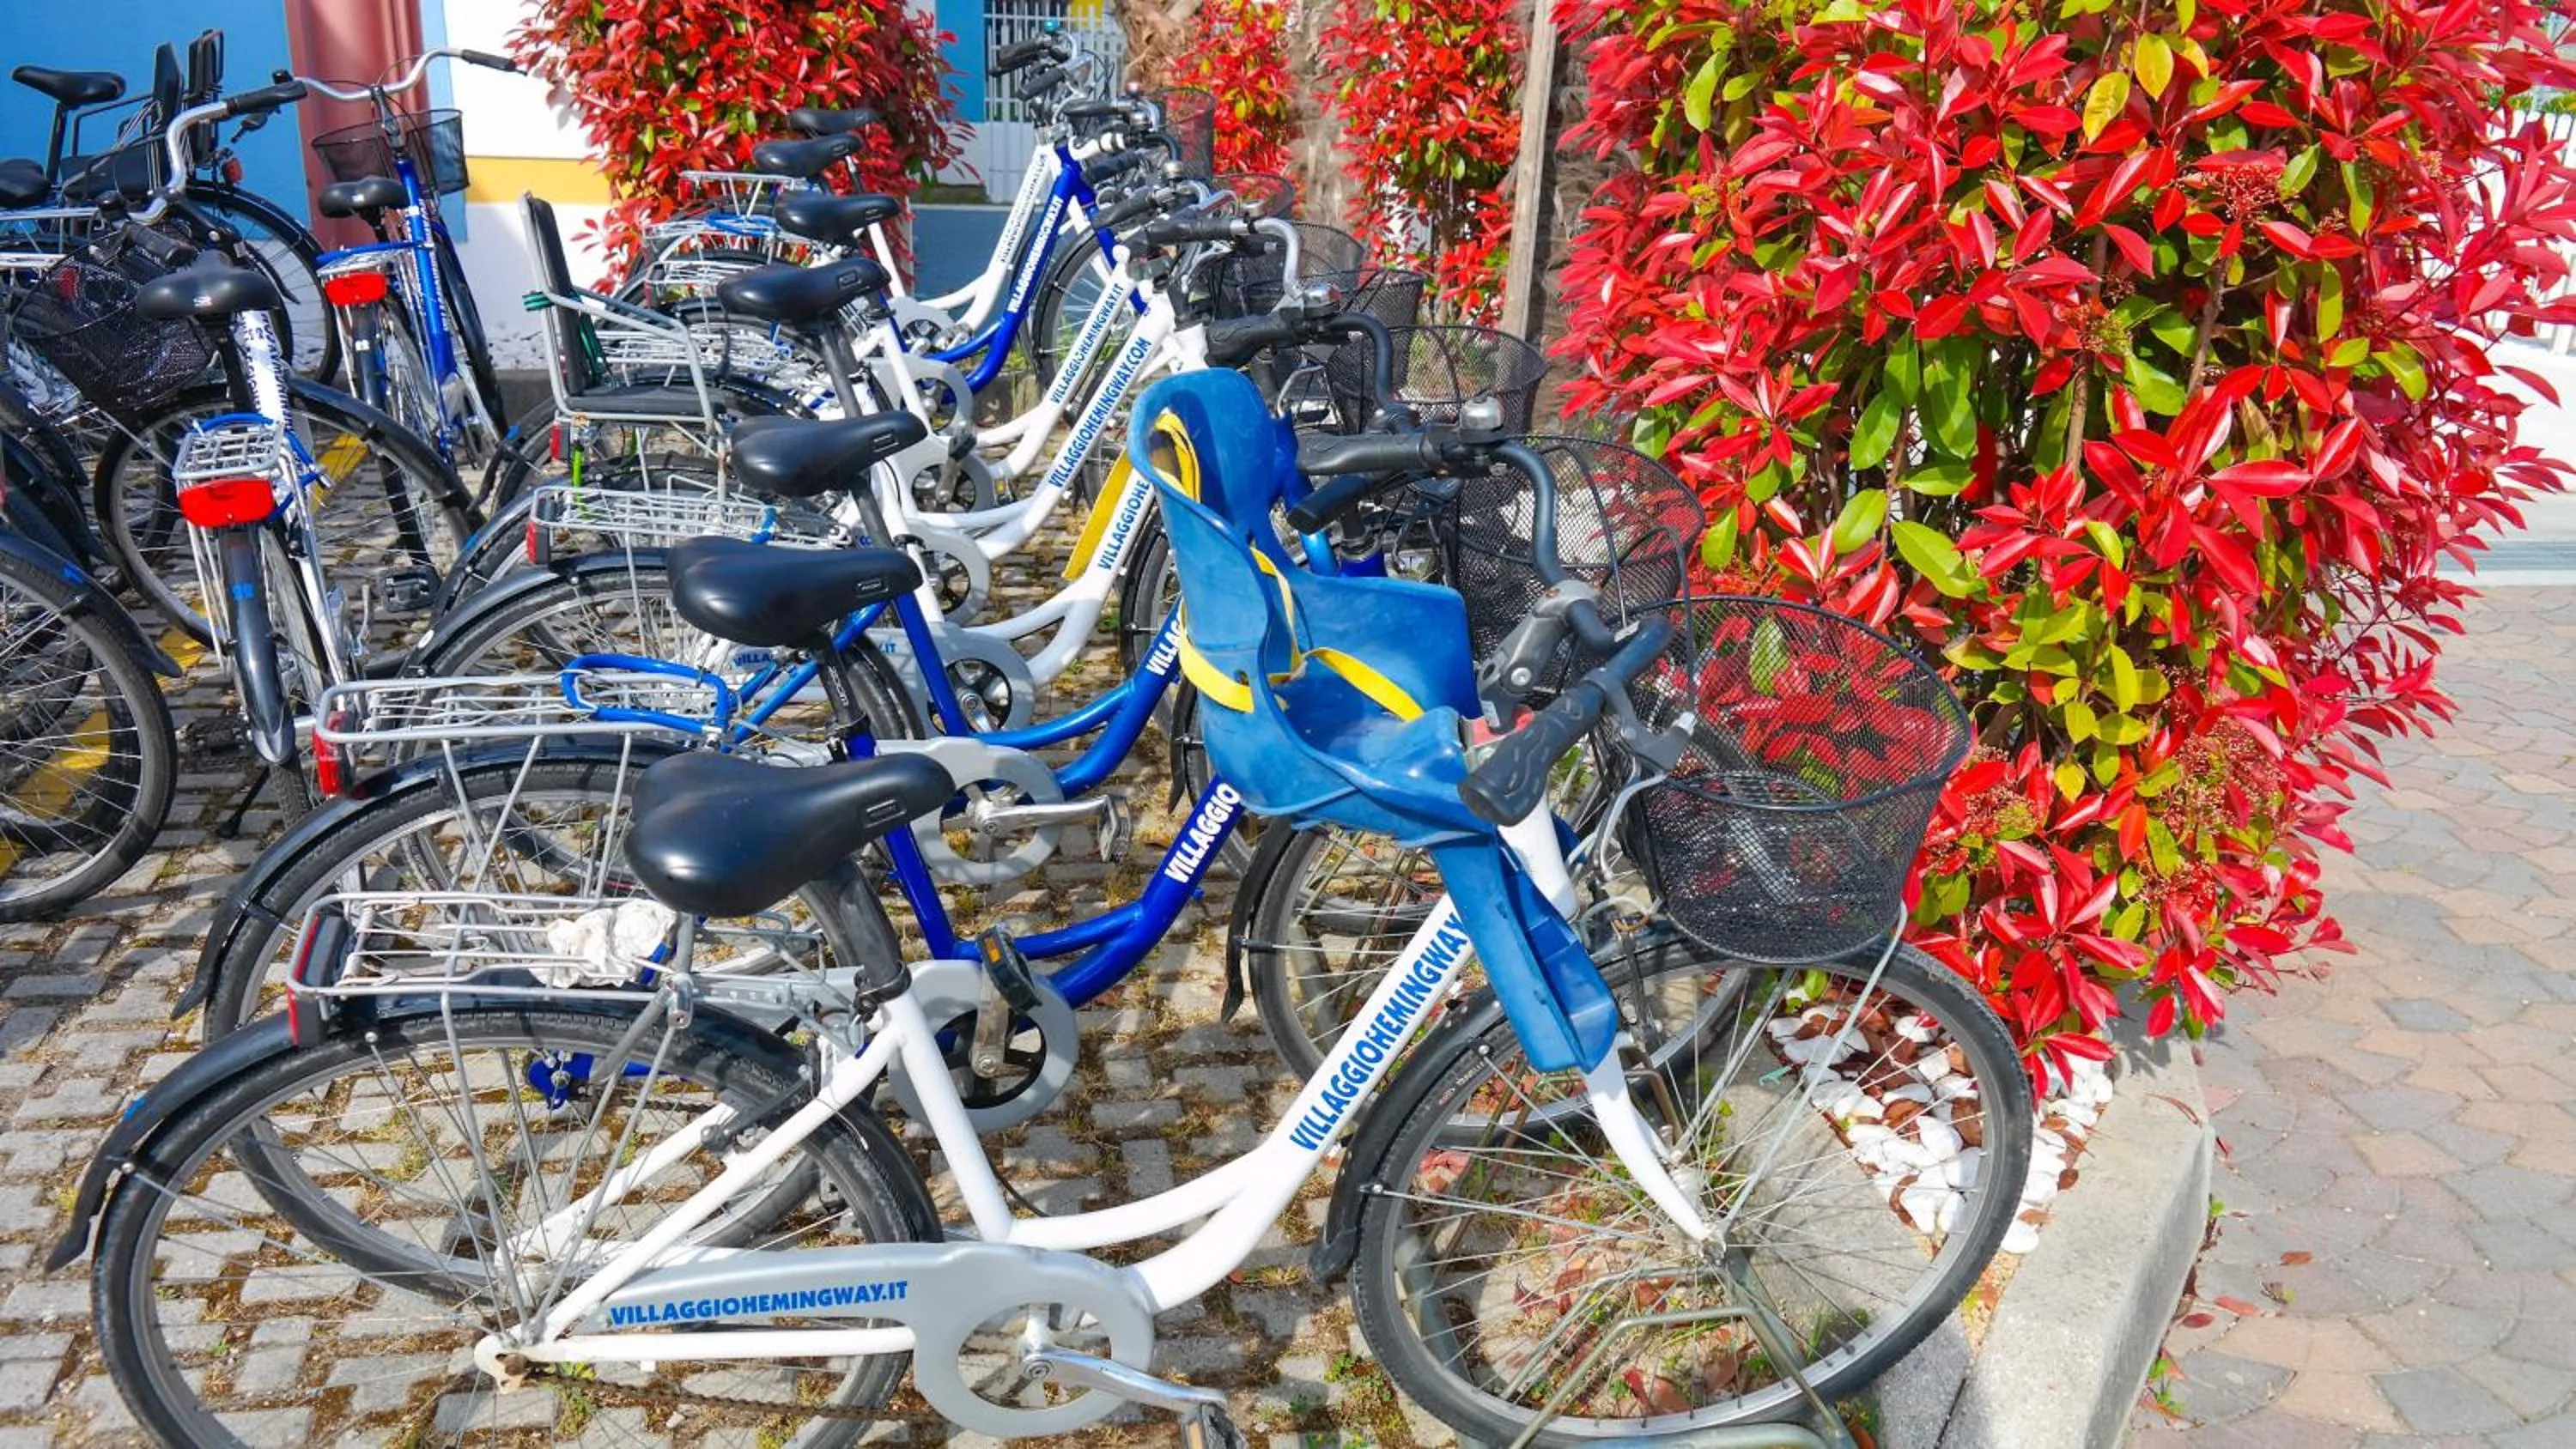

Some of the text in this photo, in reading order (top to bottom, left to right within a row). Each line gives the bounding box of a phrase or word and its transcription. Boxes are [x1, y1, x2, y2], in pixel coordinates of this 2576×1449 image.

[1049, 282, 1124, 404] VILLAGGIOHEMINGWAY.IT
[1048, 336, 1151, 489] VILLAGGIOHEMINGWAY.COM
[1097, 480, 1151, 571] VILLAGGIOHE
[1163, 782, 1241, 884] VILLAGGIO
[1289, 912, 1469, 1151] VILLAGGIOHEMINGWAY
[611, 1279, 908, 1326] VILLAGGIOHEMINGWAY.IT
